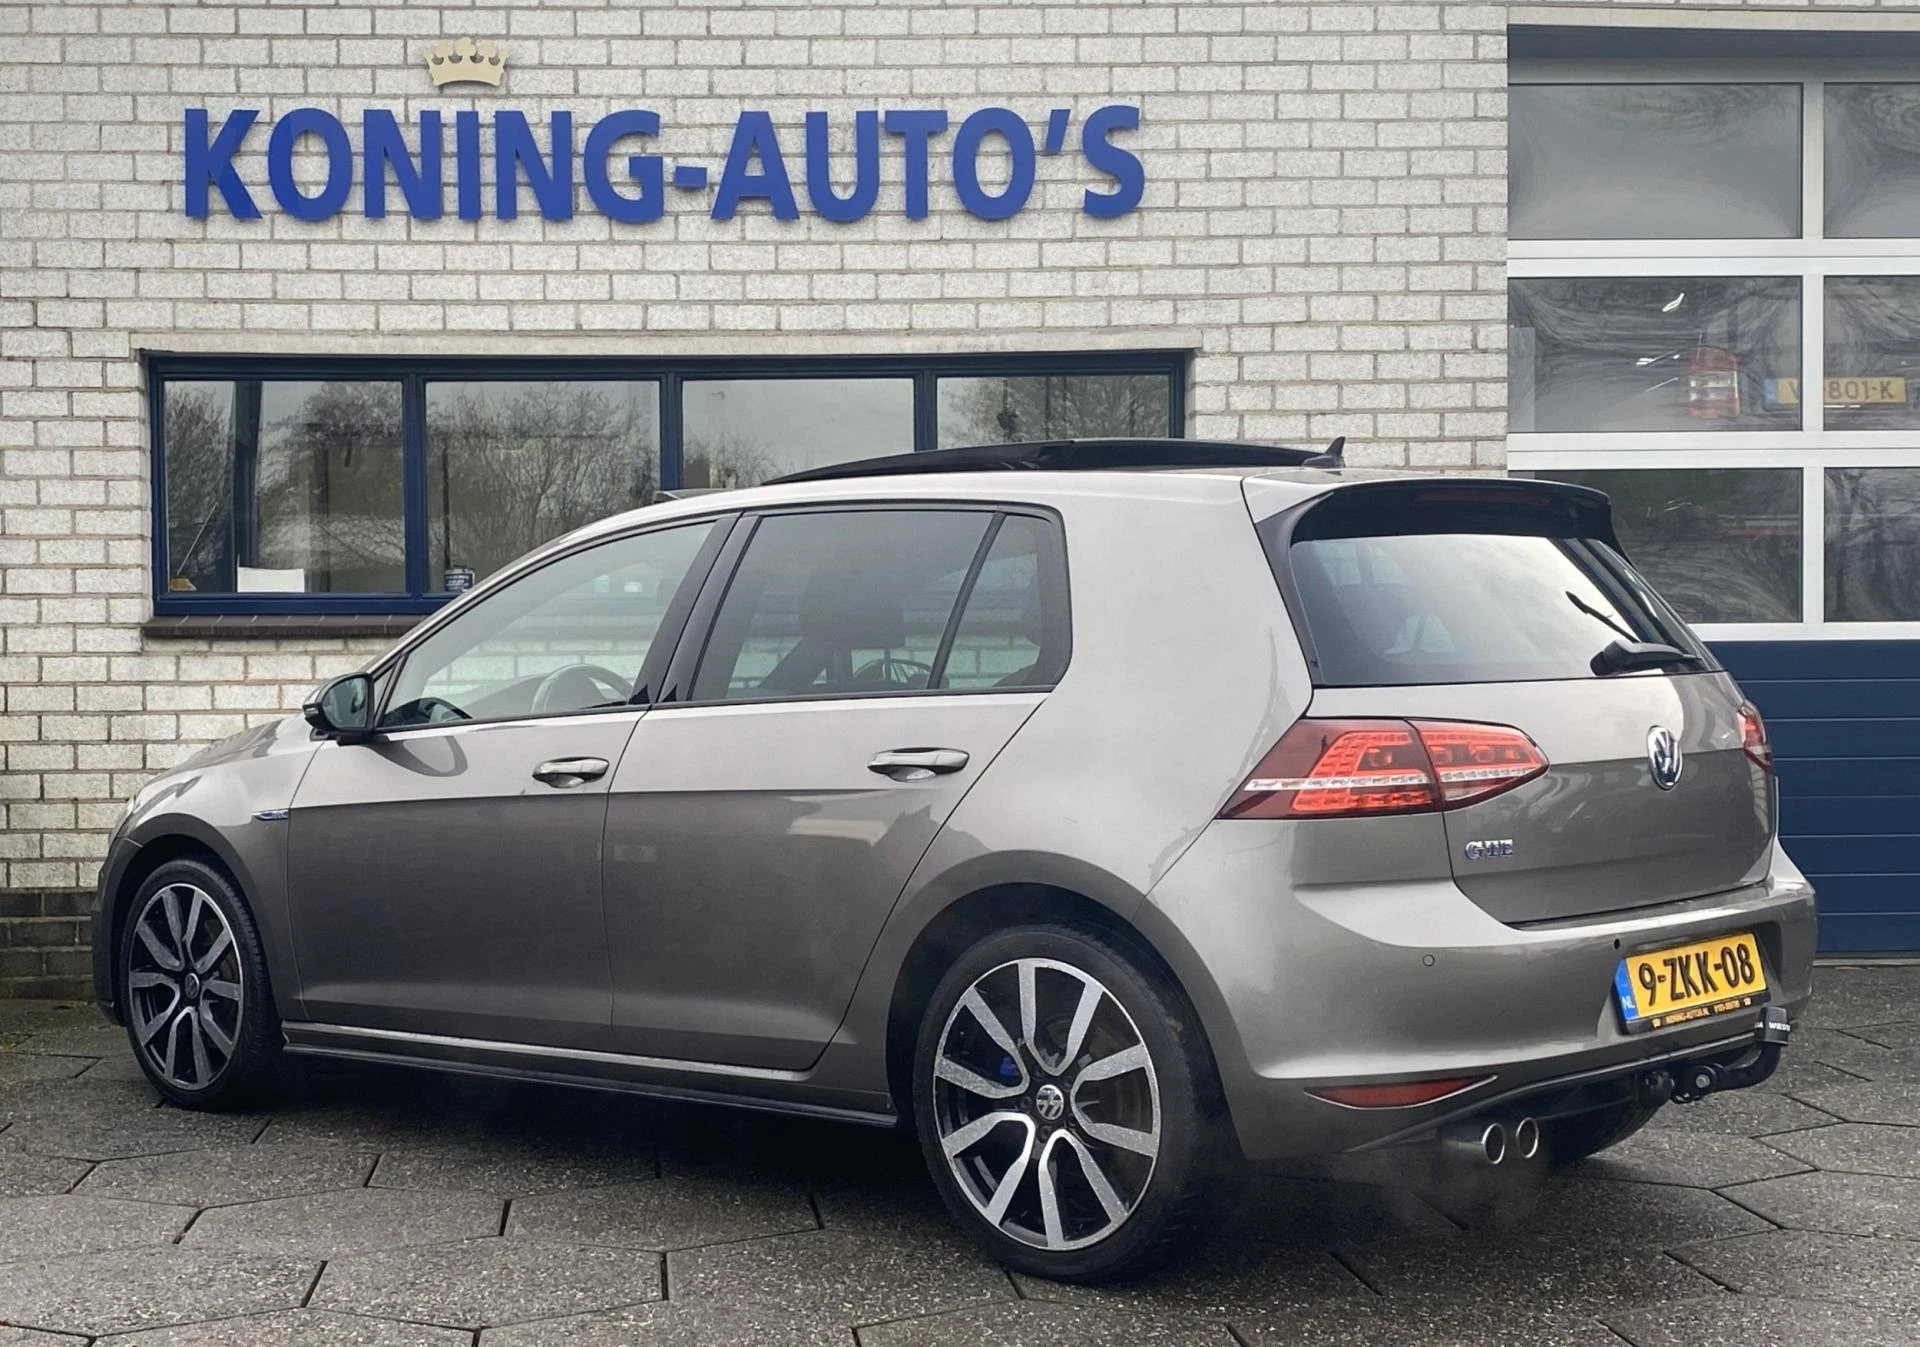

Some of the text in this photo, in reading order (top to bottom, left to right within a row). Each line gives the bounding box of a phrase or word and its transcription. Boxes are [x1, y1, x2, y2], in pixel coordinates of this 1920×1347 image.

[184, 104, 1146, 223] KONING-AUTO'S
[1465, 838, 1513, 861] GTE
[1638, 943, 1755, 1006] 9-ZKK-08
[1621, 995, 1636, 1009] NL
